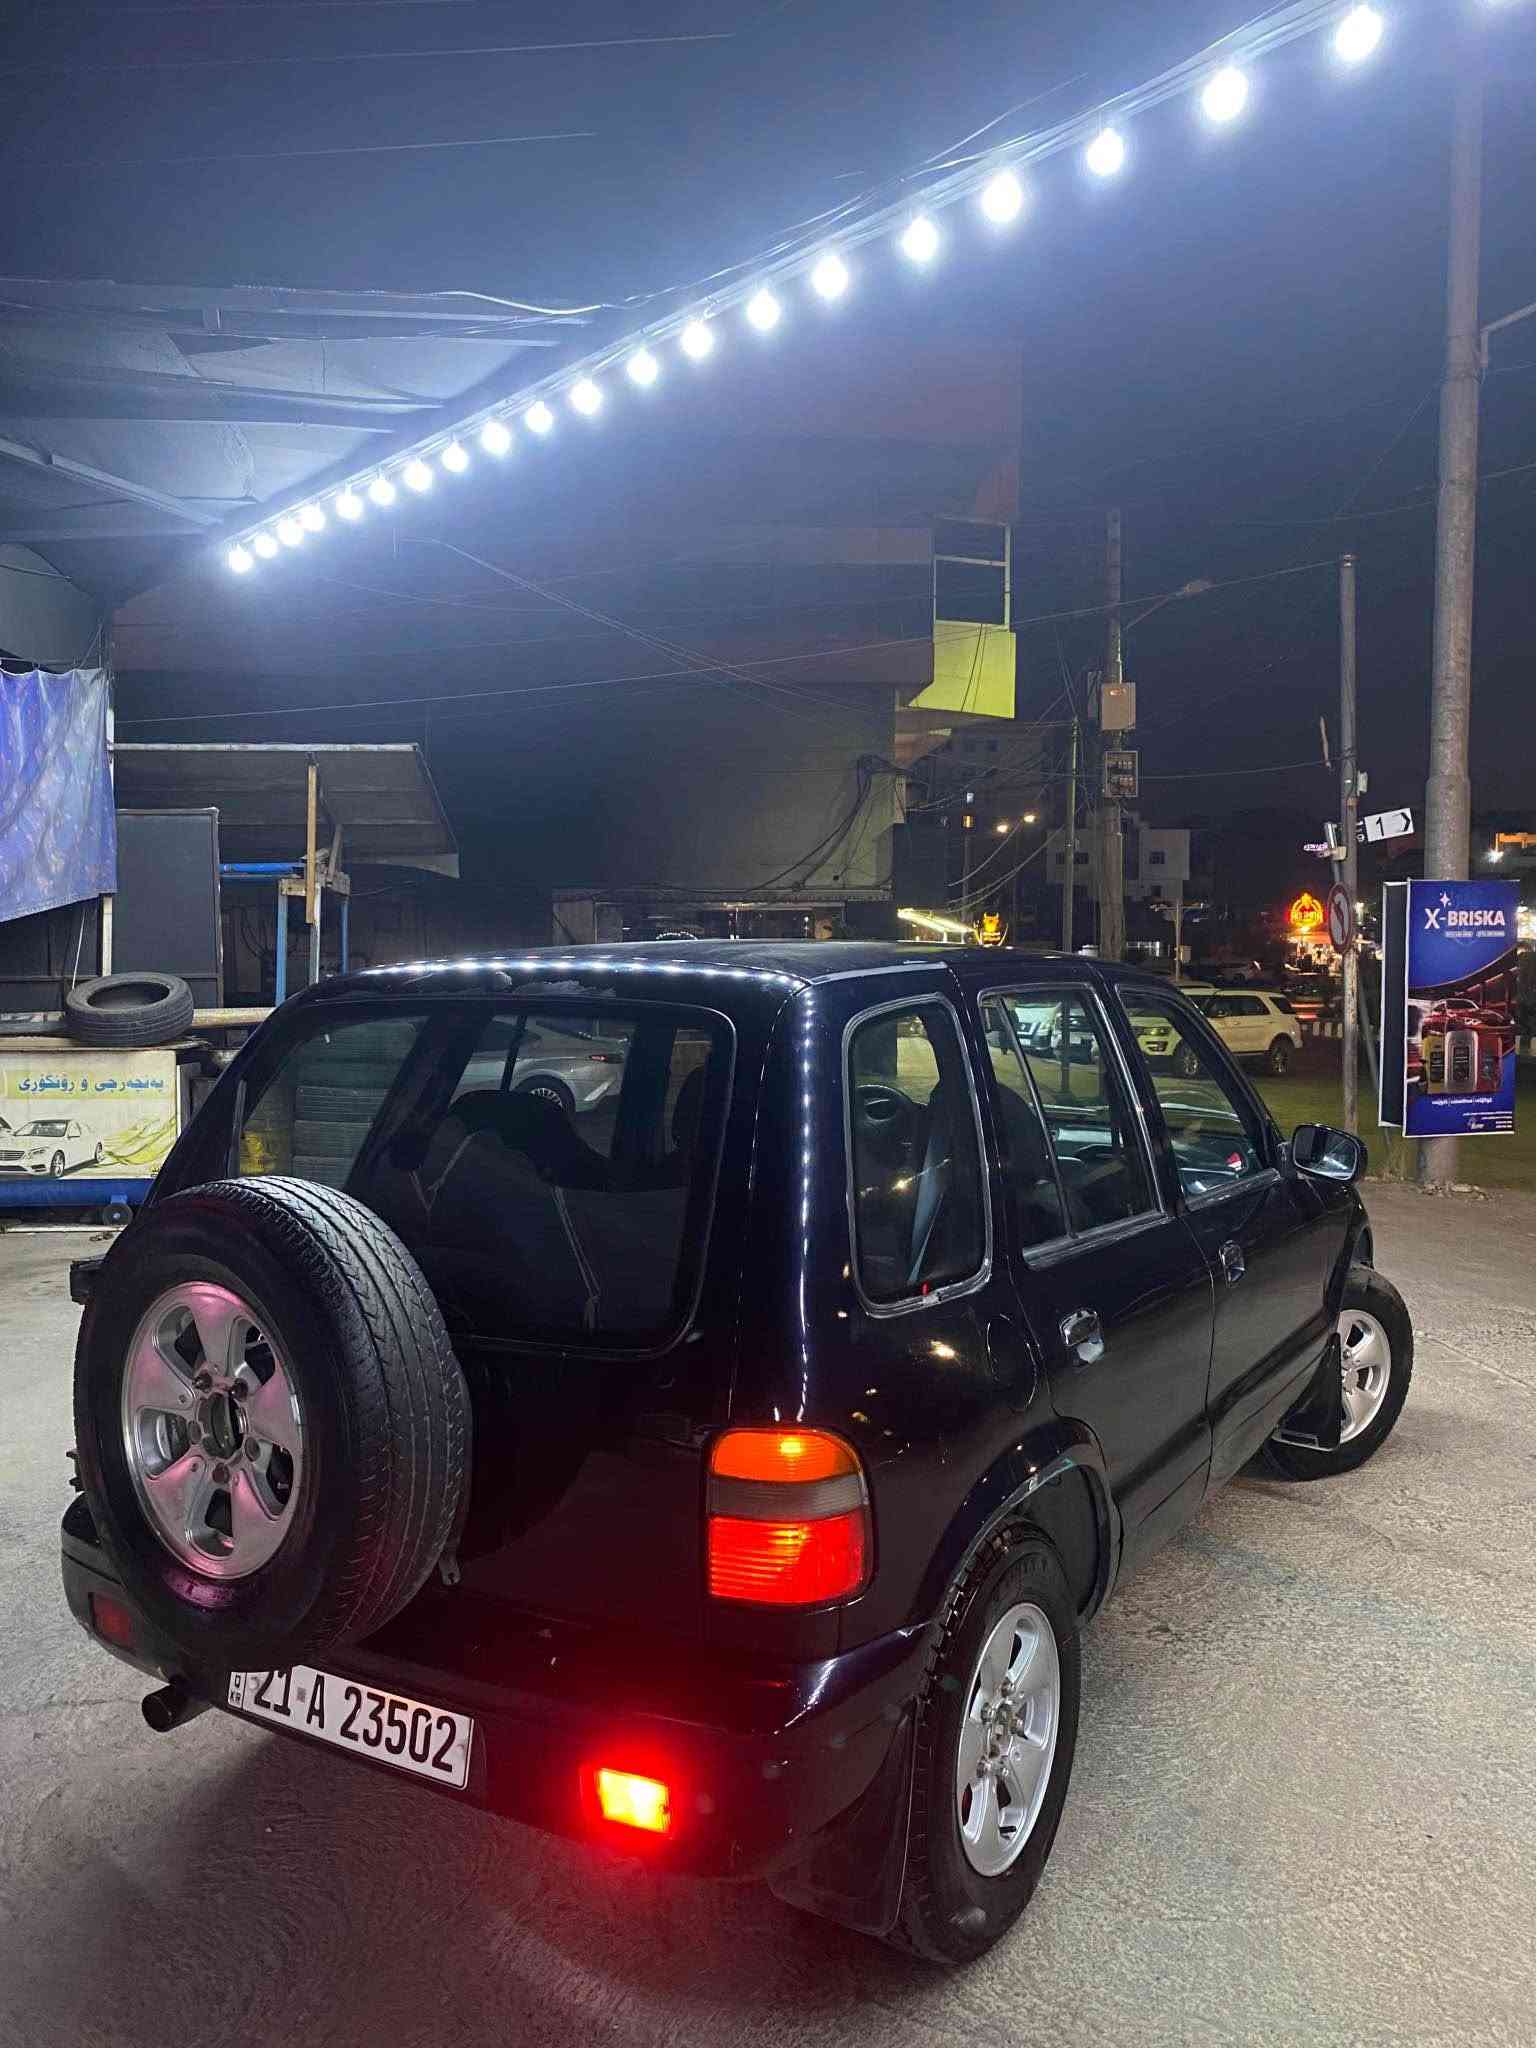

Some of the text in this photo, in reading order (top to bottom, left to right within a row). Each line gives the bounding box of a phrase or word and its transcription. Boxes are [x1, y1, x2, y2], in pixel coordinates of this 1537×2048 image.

[1424, 908, 1505, 929] X-BRISKA
[254, 1670, 458, 1773] 21 A 23502
